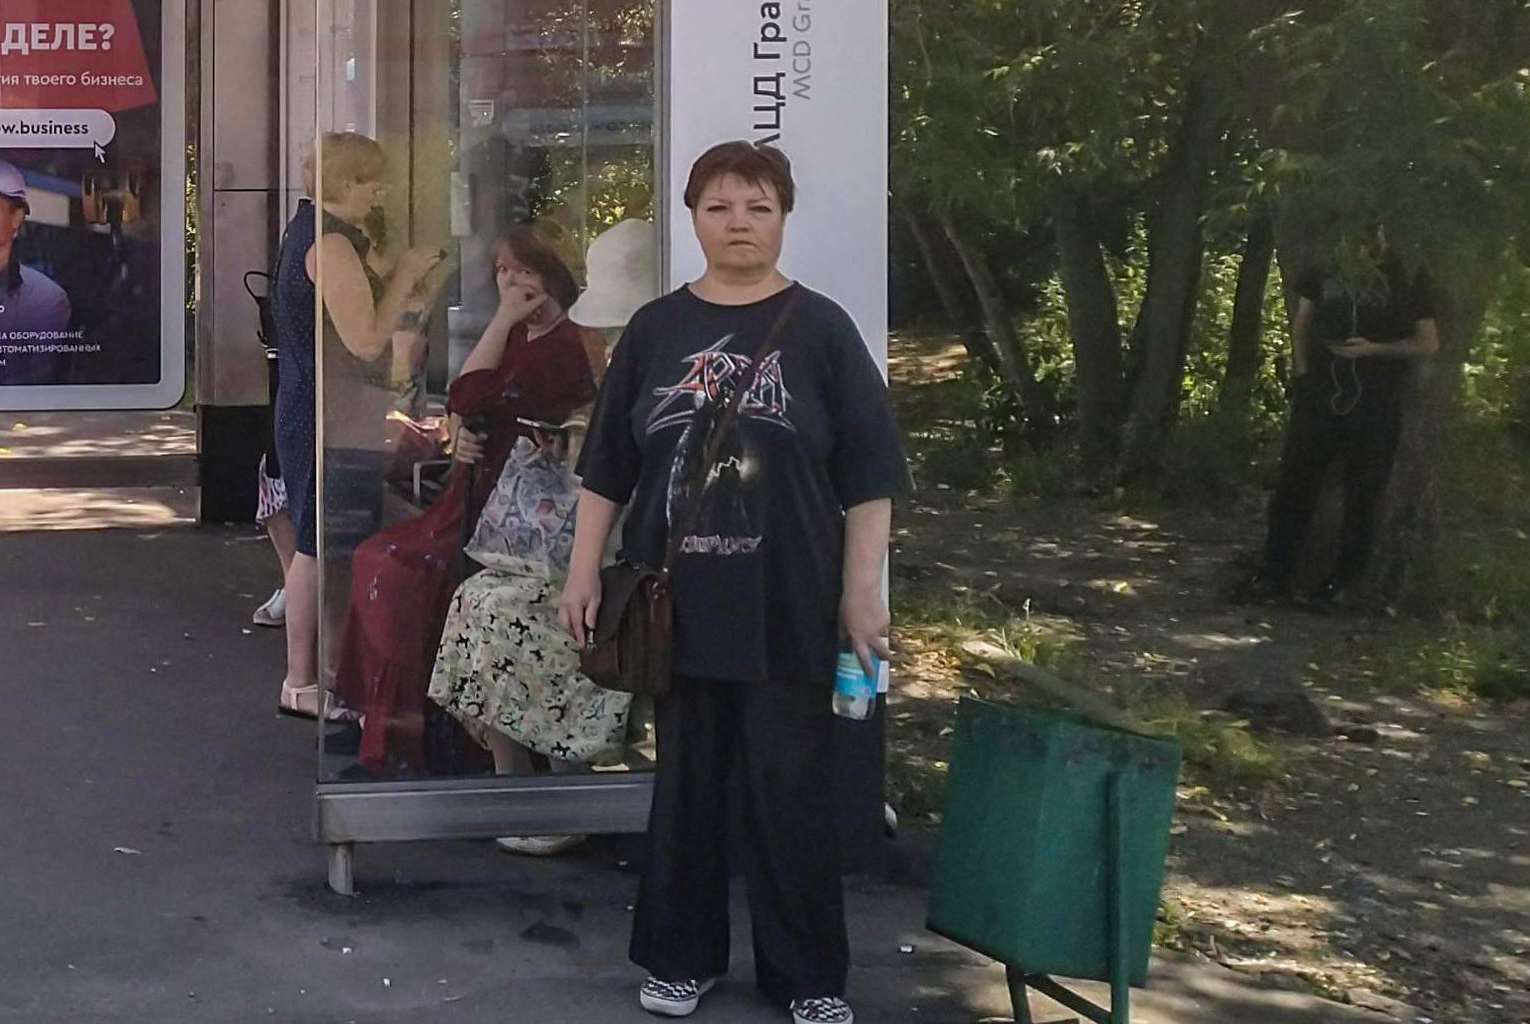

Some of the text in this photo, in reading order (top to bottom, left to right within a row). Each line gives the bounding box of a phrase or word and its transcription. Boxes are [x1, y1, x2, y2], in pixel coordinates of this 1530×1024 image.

[1, 23, 115, 56] ДЕЛЕ?
[23, 74, 76, 86] твоего
[80, 71, 143, 86] бизнеса
[792, 40, 811, 100] MCD
[9, 331, 84, 340] ОБОРУДОВАНИЕ
